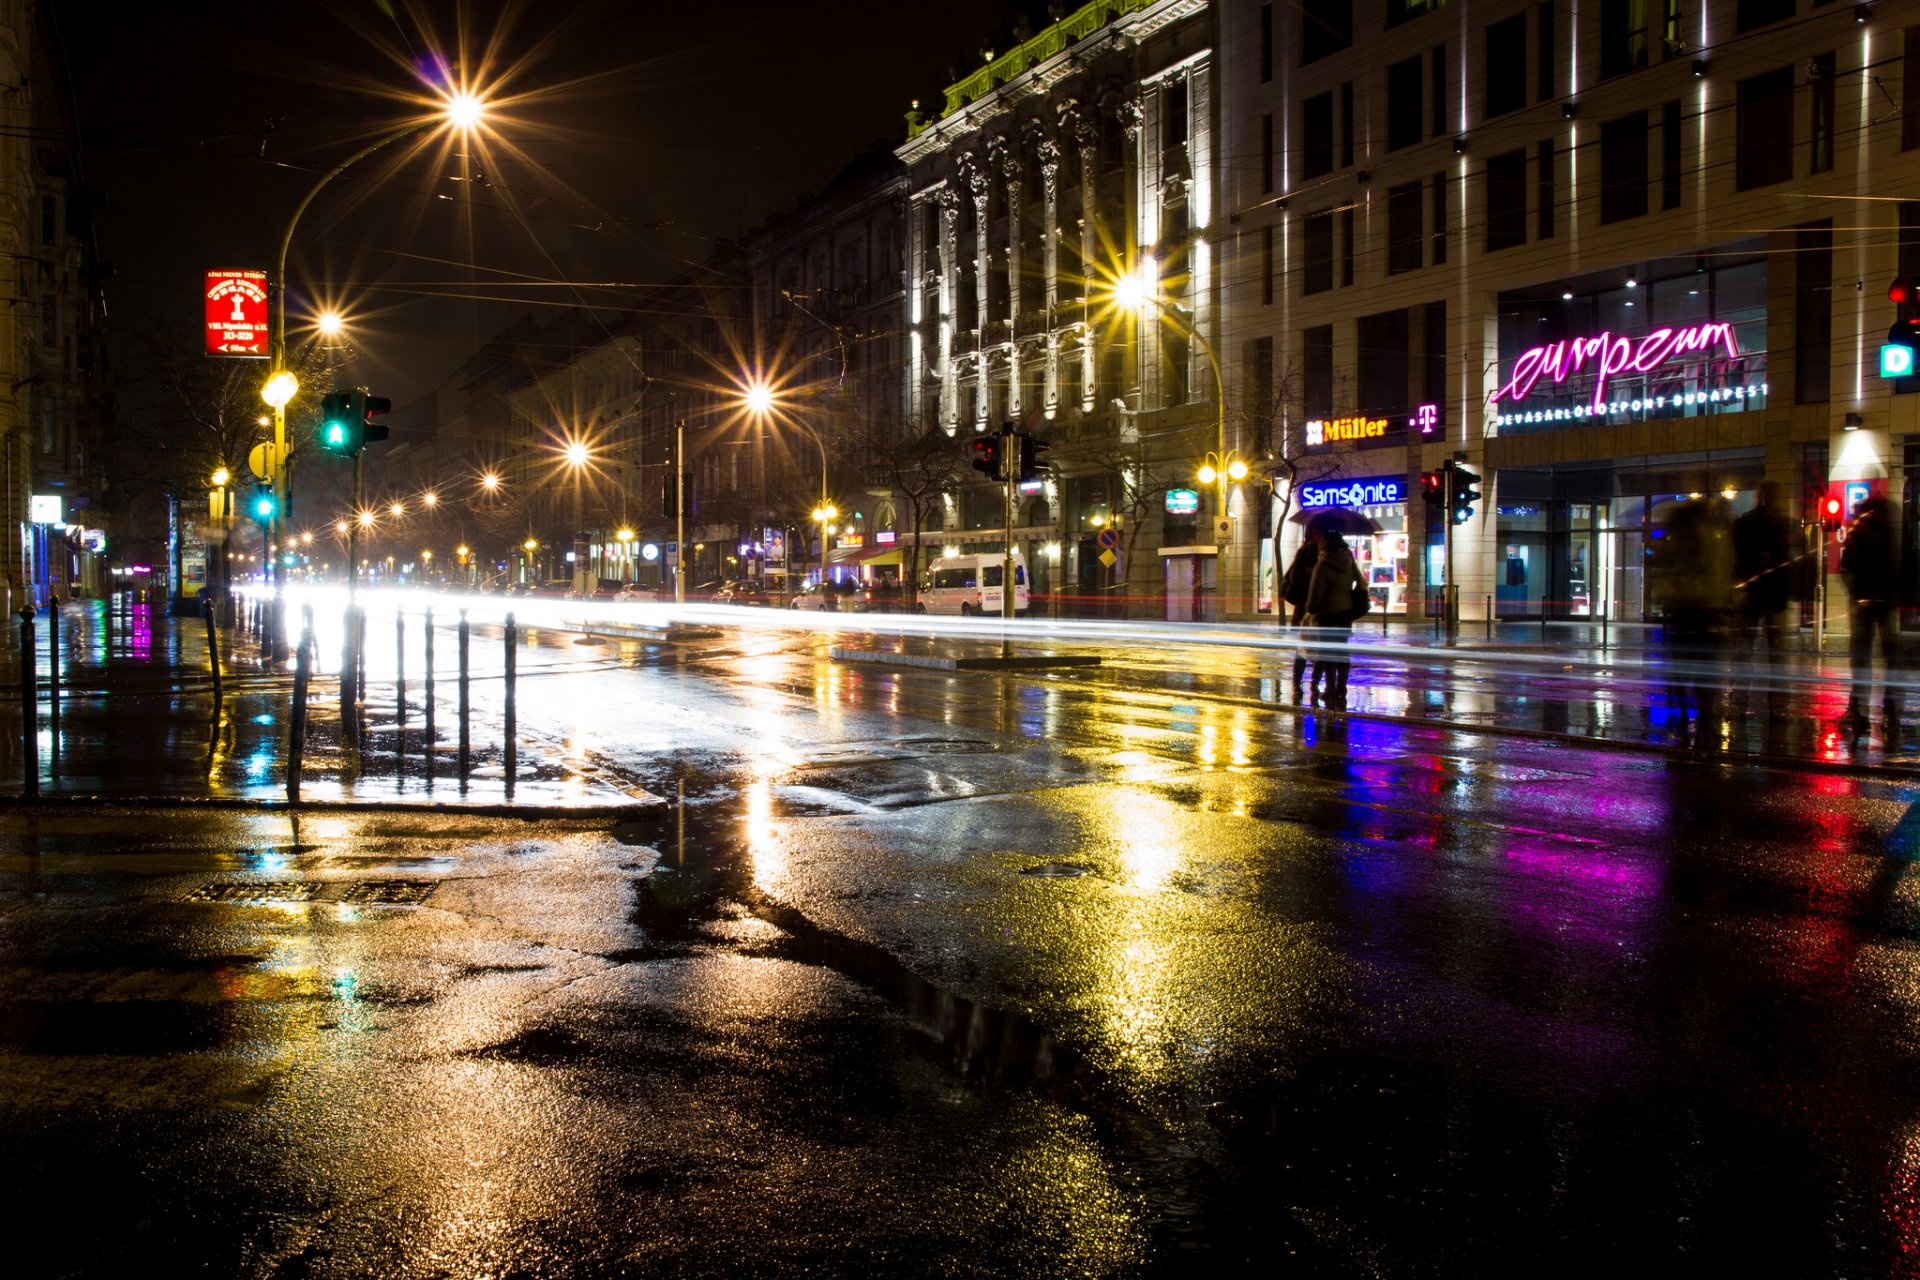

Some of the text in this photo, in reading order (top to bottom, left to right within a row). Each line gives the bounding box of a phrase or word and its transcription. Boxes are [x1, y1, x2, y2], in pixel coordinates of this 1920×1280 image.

[1491, 321, 1740, 415] europeum
[1884, 347, 1911, 373] D
[1673, 383, 1769, 407] BUDAPEST
[1323, 416, 1388, 442] Müller
[1302, 482, 1398, 507] Samsonite
[1848, 487, 1870, 516] P
